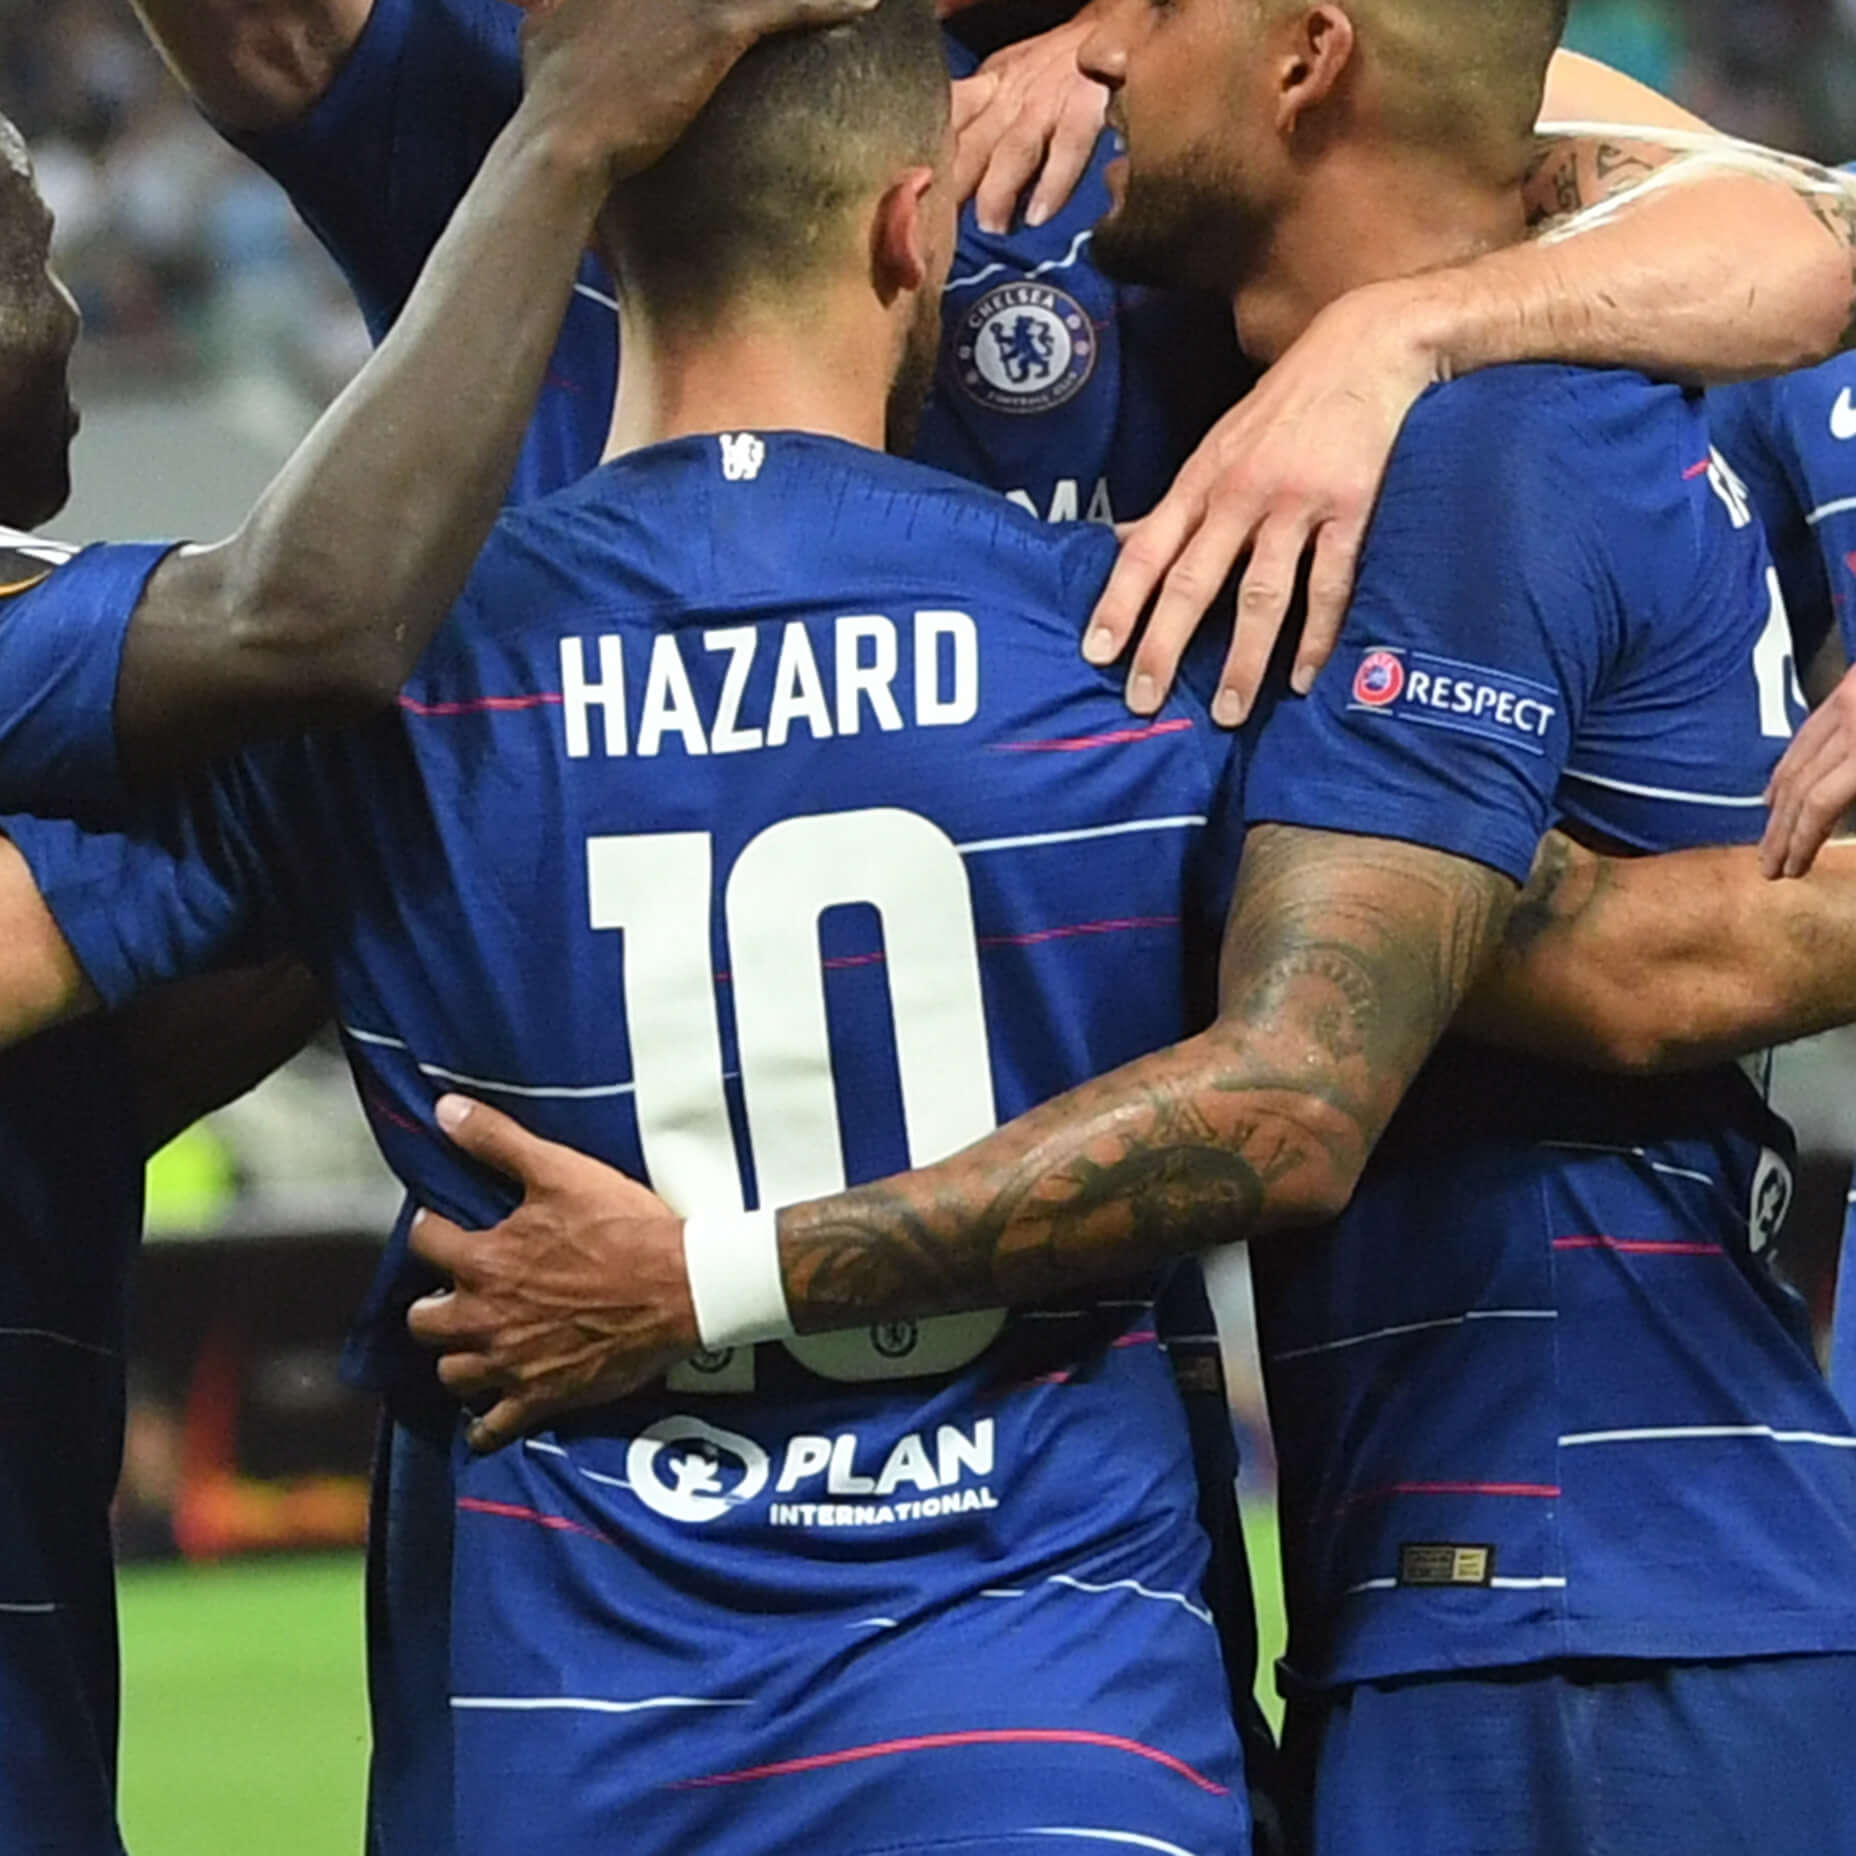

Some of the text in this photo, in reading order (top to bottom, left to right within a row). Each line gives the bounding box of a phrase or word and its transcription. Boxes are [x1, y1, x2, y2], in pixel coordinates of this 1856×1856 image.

[968, 287, 1055, 328] CHELSEA
[559, 609, 979, 757] HAZARD
[1406, 670, 1556, 737] RESPECT
[586, 806, 1004, 1392] 10
[775, 1417, 995, 1495] PLAN
[769, 1486, 999, 1526] INTERNATIONAL
